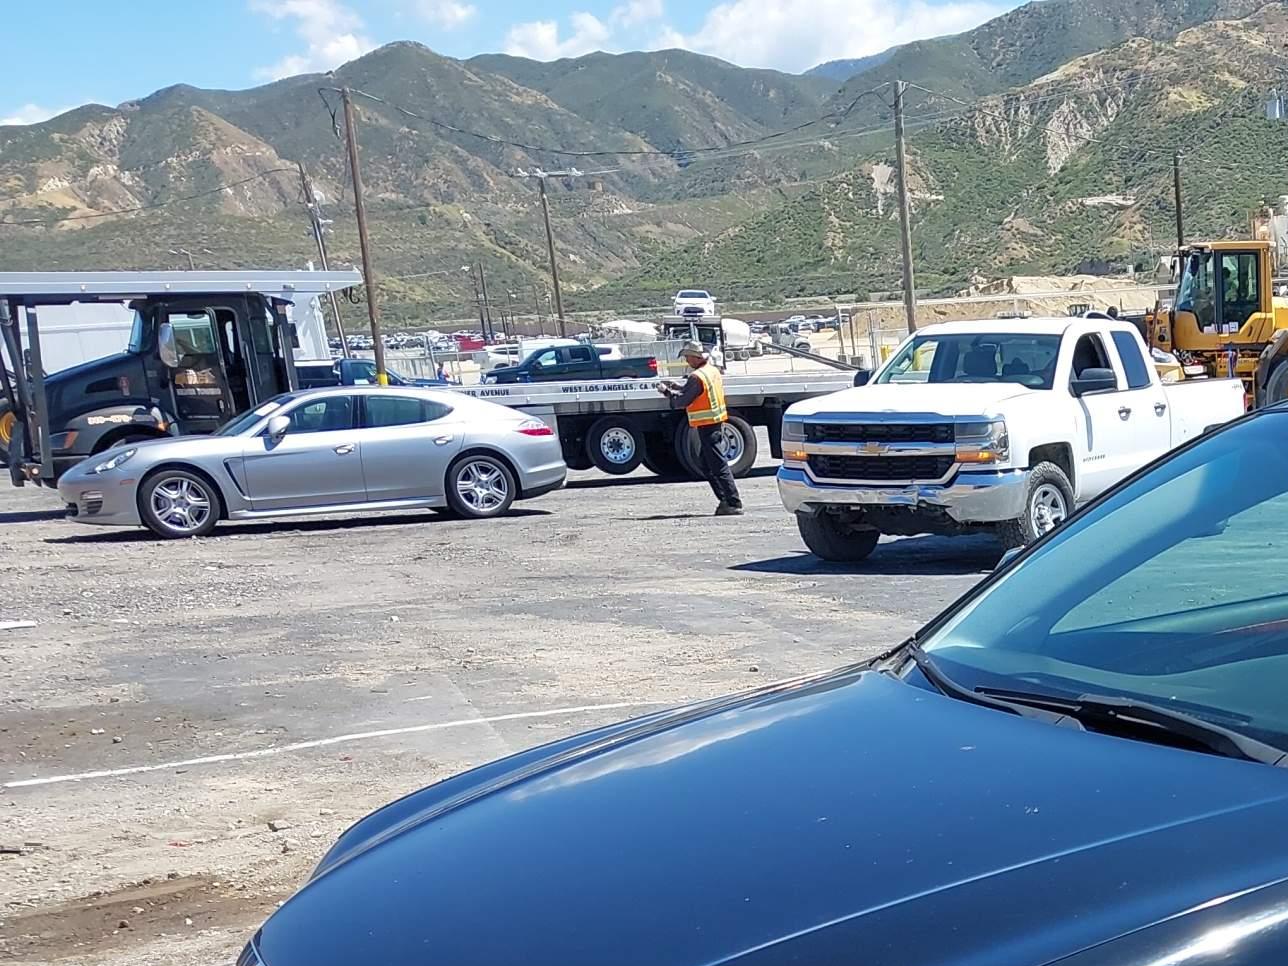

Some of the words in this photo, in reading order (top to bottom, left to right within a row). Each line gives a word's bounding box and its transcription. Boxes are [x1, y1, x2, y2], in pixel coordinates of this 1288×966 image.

[562, 385, 582, 393] WEST
[585, 384, 600, 392] LOS
[602, 382, 637, 391] ANGELES,
[640, 382, 648, 390] CA
[480, 389, 510, 397] AVENUE
